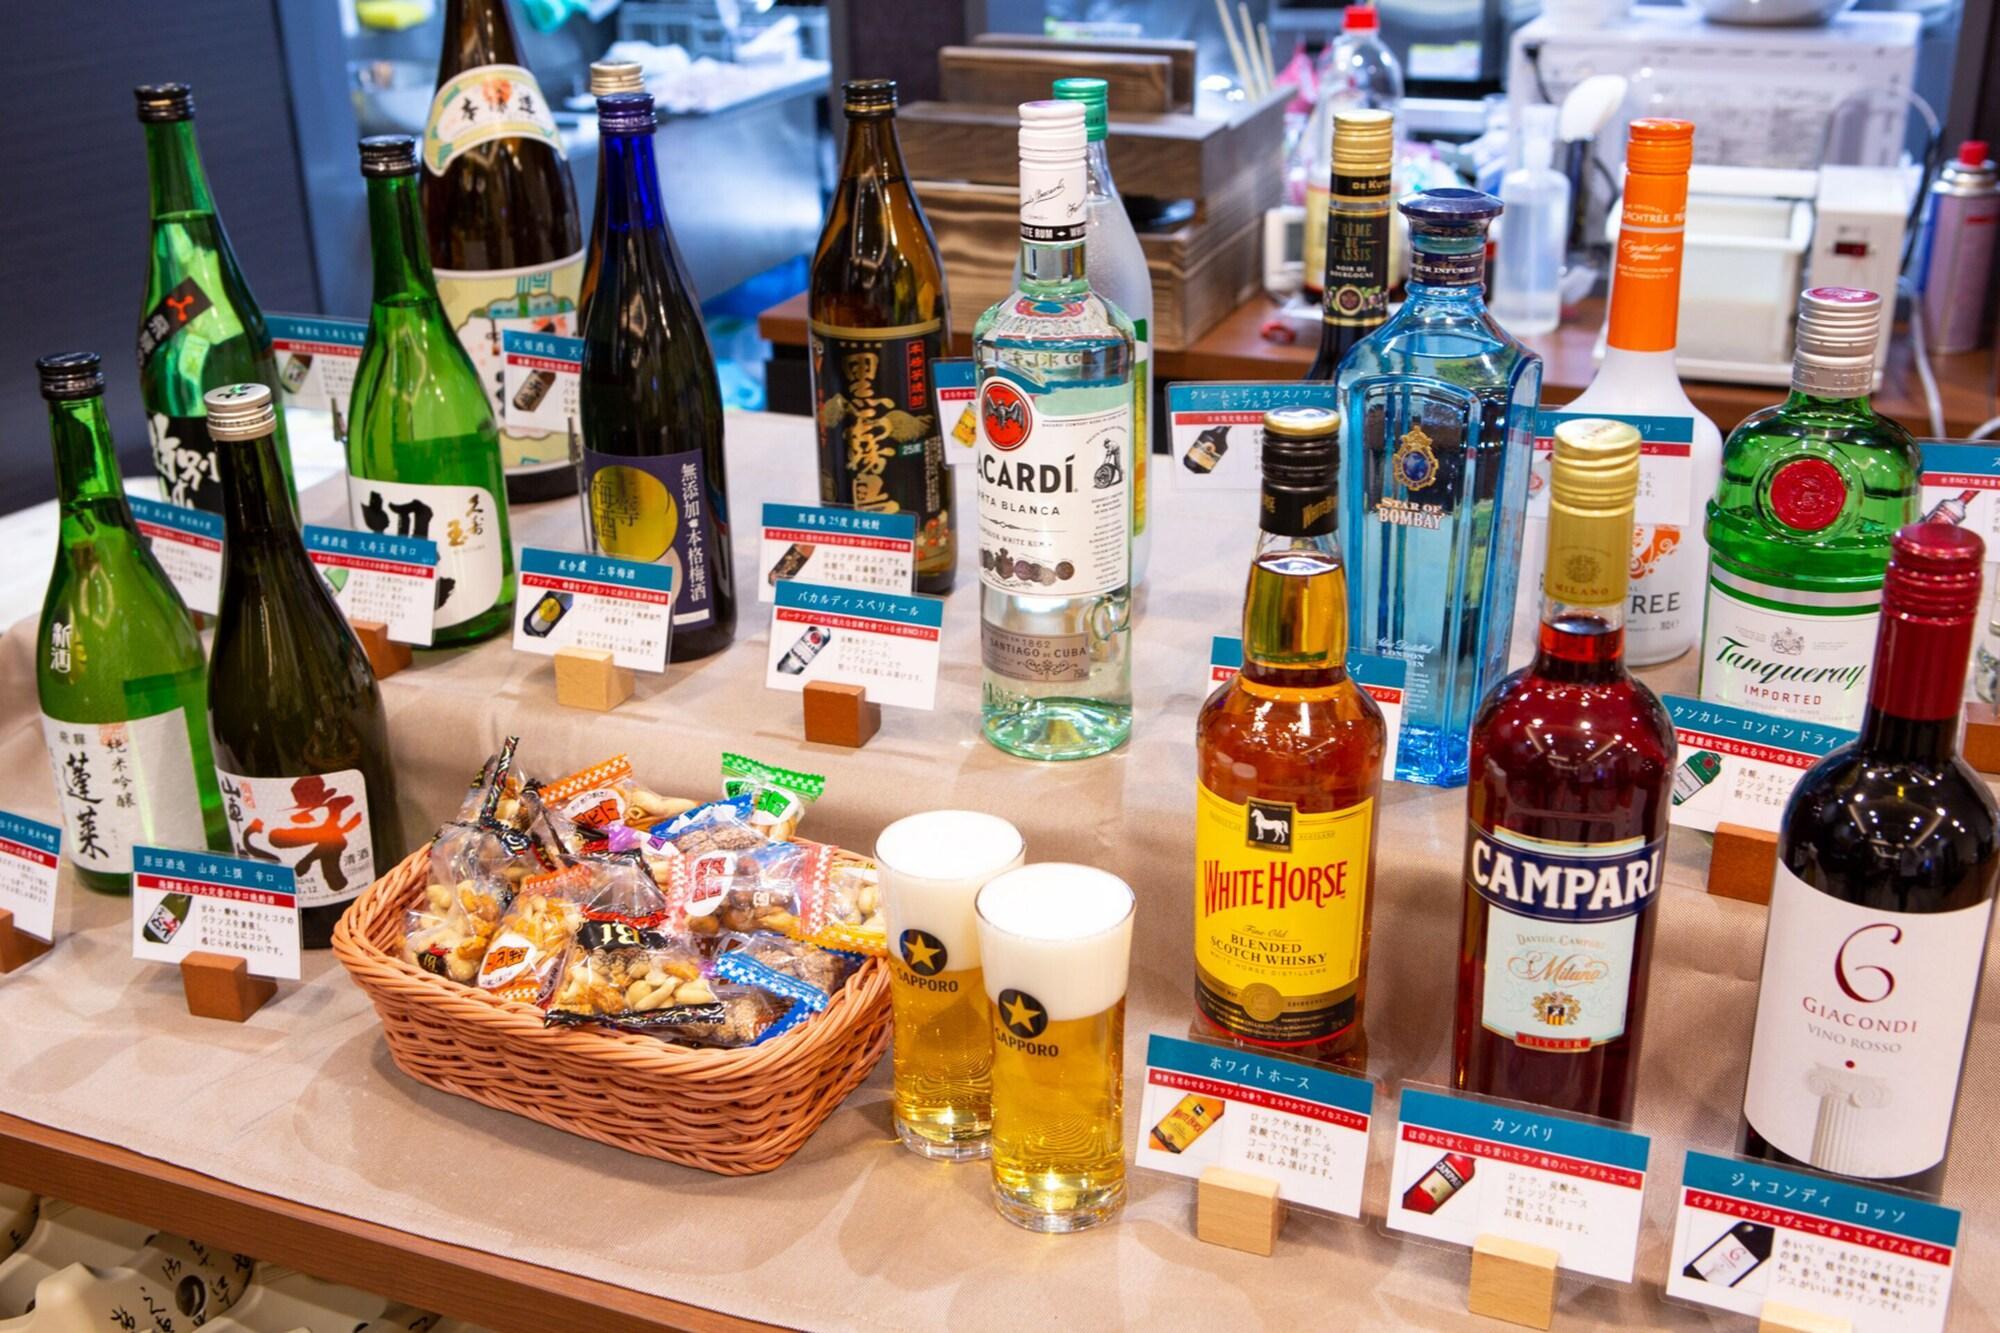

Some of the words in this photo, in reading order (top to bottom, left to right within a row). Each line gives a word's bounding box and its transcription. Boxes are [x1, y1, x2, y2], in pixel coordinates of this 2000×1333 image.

[1035, 227, 1053, 239] RUM
[1434, 265, 1476, 274] INFUSED
[977, 451, 1075, 494] ACARDÍ
[1001, 501, 1061, 516] BLANCA
[1381, 497, 1420, 511] STAR
[1422, 503, 1443, 513] OF
[1377, 508, 1444, 530] BOMBAY
[1555, 584, 1609, 596] MILANO
[797, 591, 850, 607] バカルディ
[854, 598, 920, 616] スペリオール
[990, 638, 1041, 658] SANTIAGO
[1054, 647, 1087, 658] CUBA
[1022, 640, 1051, 649] 1862
[1716, 635, 1867, 691] Tanqueray
[1744, 684, 1822, 706] IMPORTED
[1673, 705, 1737, 726] タンカレー
[1742, 719, 1795, 738] ロンドン
[1800, 729, 1839, 749] ドライ
[63, 751, 109, 860] 蓬莱
[255, 871, 275, 883] 辛口
[1472, 839, 1661, 912] CAMPARI
[1204, 860, 1264, 918] WHITE
[1268, 860, 1348, 909] HORSE
[1210, 935, 1262, 964] SCOTCH
[1265, 951, 1328, 965] WHISKY
[1231, 933, 1303, 954] BLENDED
[896, 967, 959, 993] SAPPORO
[1802, 996, 1918, 1034] GIACONDI
[993, 1026, 1060, 1058] SAPPORO
[1524, 1033, 1584, 1050] BITTER
[1807, 1022, 1847, 1047] VINO
[1850, 1038, 1902, 1055] ROSSO
[1209, 1056, 1311, 1090] ホワイトホース
[1491, 1116, 1554, 1142] カンパリ
[1692, 1194, 1735, 1215] イタリア
[1730, 1172, 1831, 1209] ジャコンディ
[1855, 1200, 1907, 1224] ロッソ
